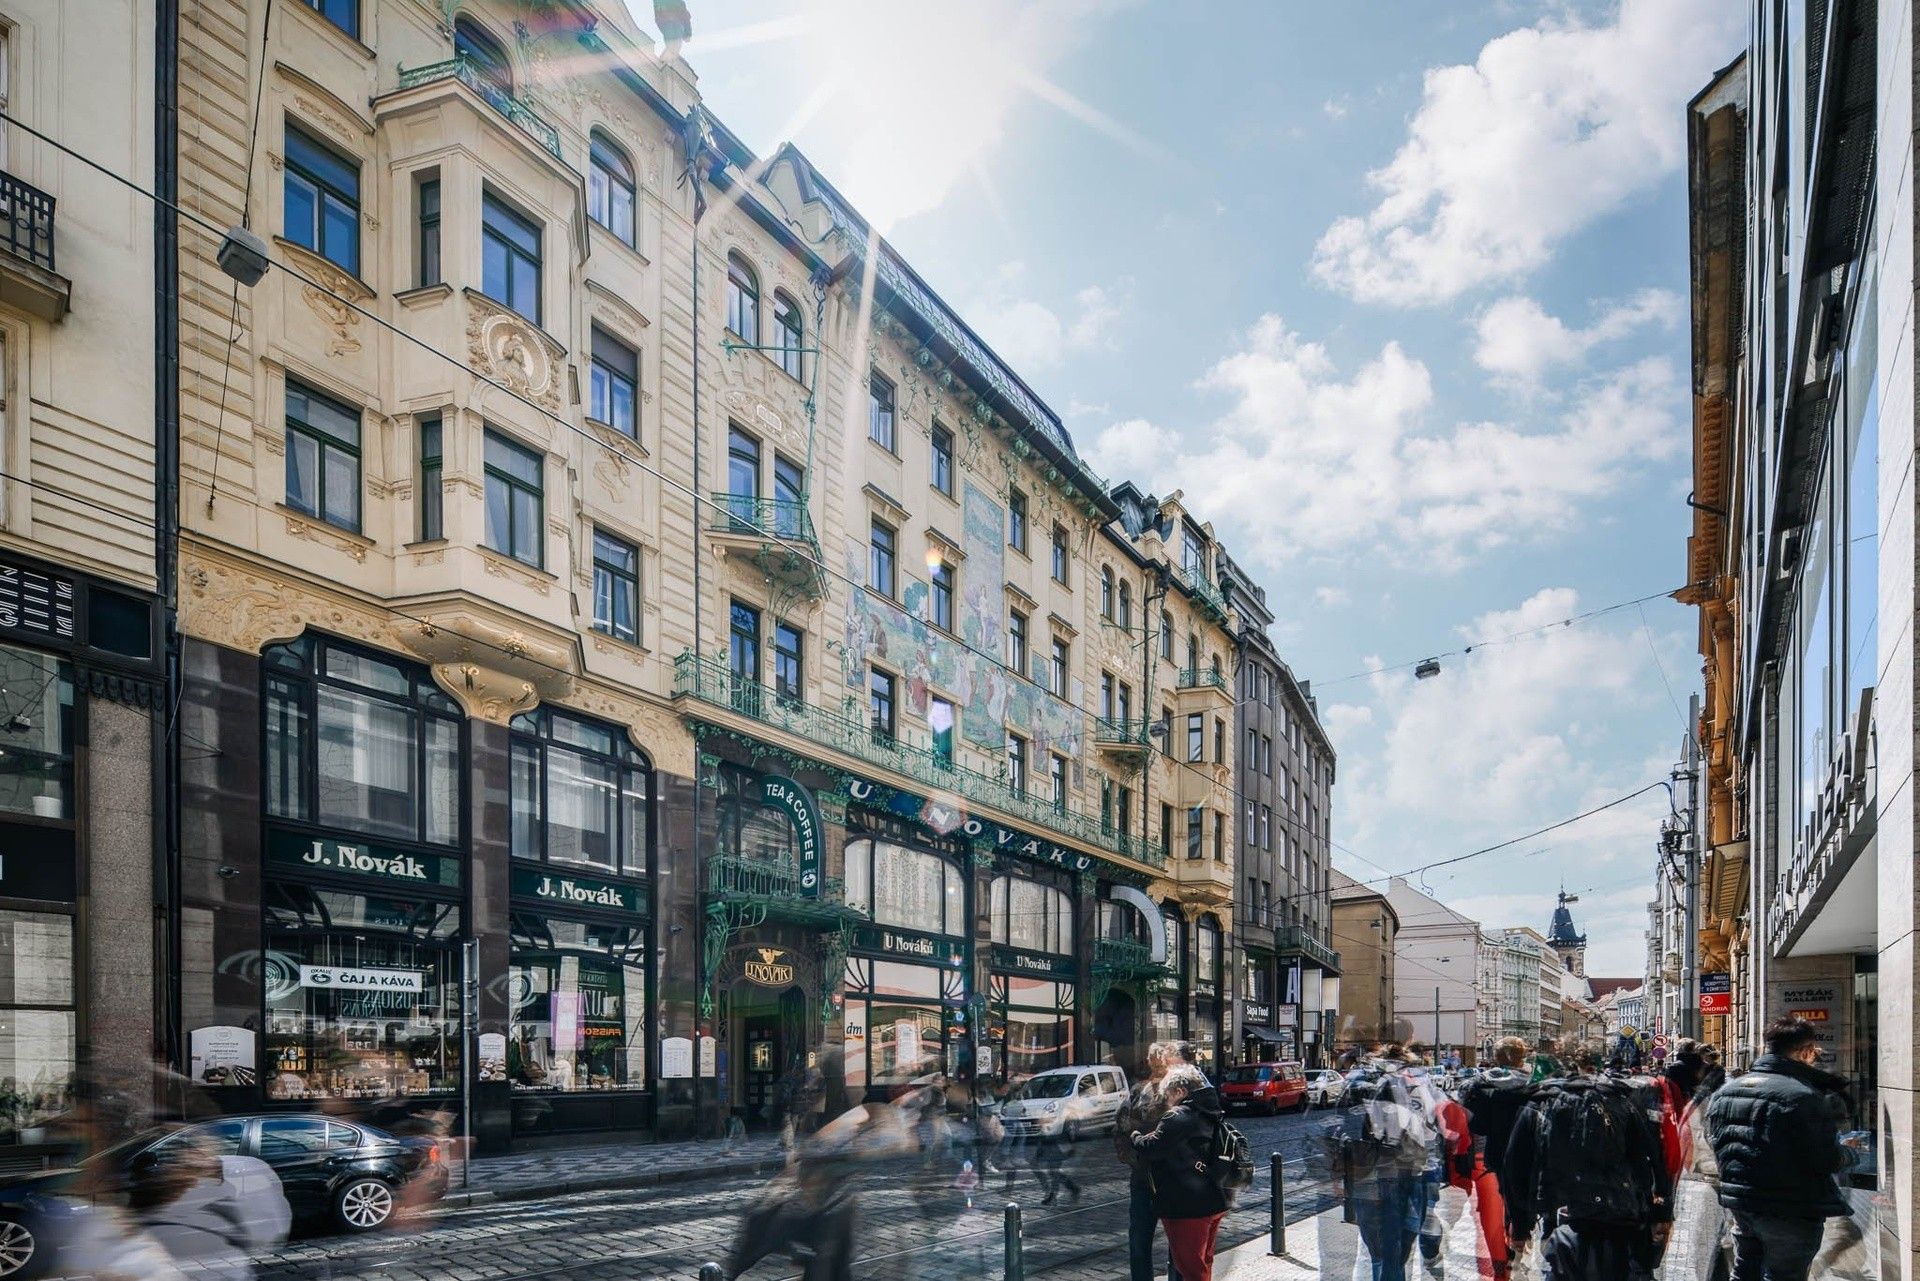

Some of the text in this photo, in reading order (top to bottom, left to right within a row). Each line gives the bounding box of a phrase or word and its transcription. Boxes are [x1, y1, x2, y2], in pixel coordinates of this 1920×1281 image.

[850, 780, 873, 799] U
[766, 783, 786, 799] TEA
[786, 791, 795, 805] &
[794, 800, 814, 861] COFFEE
[302, 841, 427, 879] J. Novák
[536, 877, 624, 907] J. Novák
[885, 935, 894, 949] U
[1016, 955, 1023, 967] U
[340, 972, 414, 987] ČAJ A KÁVA
[1258, 1006, 1269, 1017] Food
[846, 1022, 863, 1034] dm
